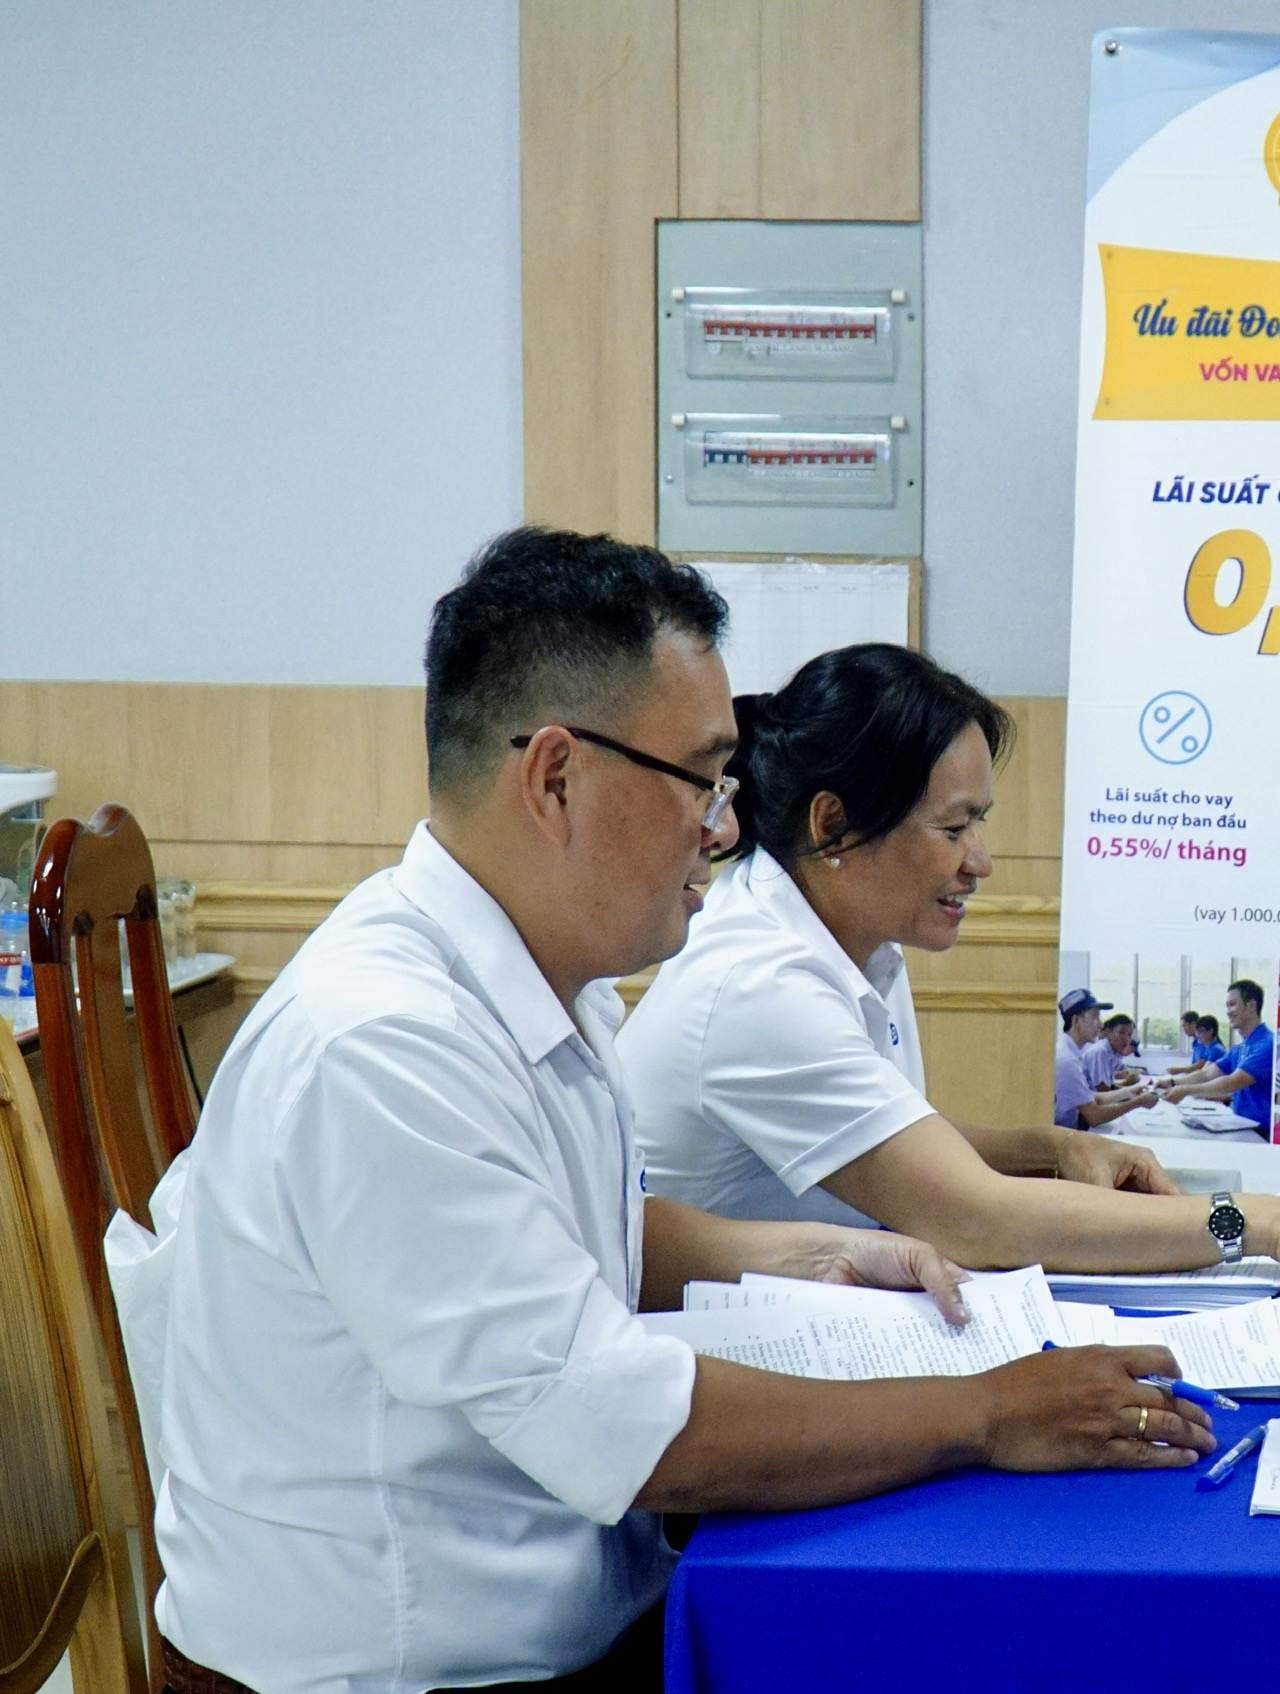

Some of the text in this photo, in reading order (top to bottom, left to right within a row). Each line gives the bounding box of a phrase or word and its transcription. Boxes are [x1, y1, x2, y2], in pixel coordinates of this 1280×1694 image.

[1133, 298, 1178, 337] Ưu
[1187, 306, 1232, 336] đãi
[1199, 356, 1249, 382] VỐN
[1152, 475, 1195, 503] LÃI
[1199, 474, 1271, 505] SUẤT
[1106, 787, 1232, 809] Lãi suất cho vay
[1090, 809, 1127, 823] theo
[1132, 812, 1154, 824] dư
[1158, 816, 1178, 829] nợ
[1182, 813, 1211, 827] ban
[1178, 840, 1246, 867] tháng
[1195, 906, 1226, 924] (vay
